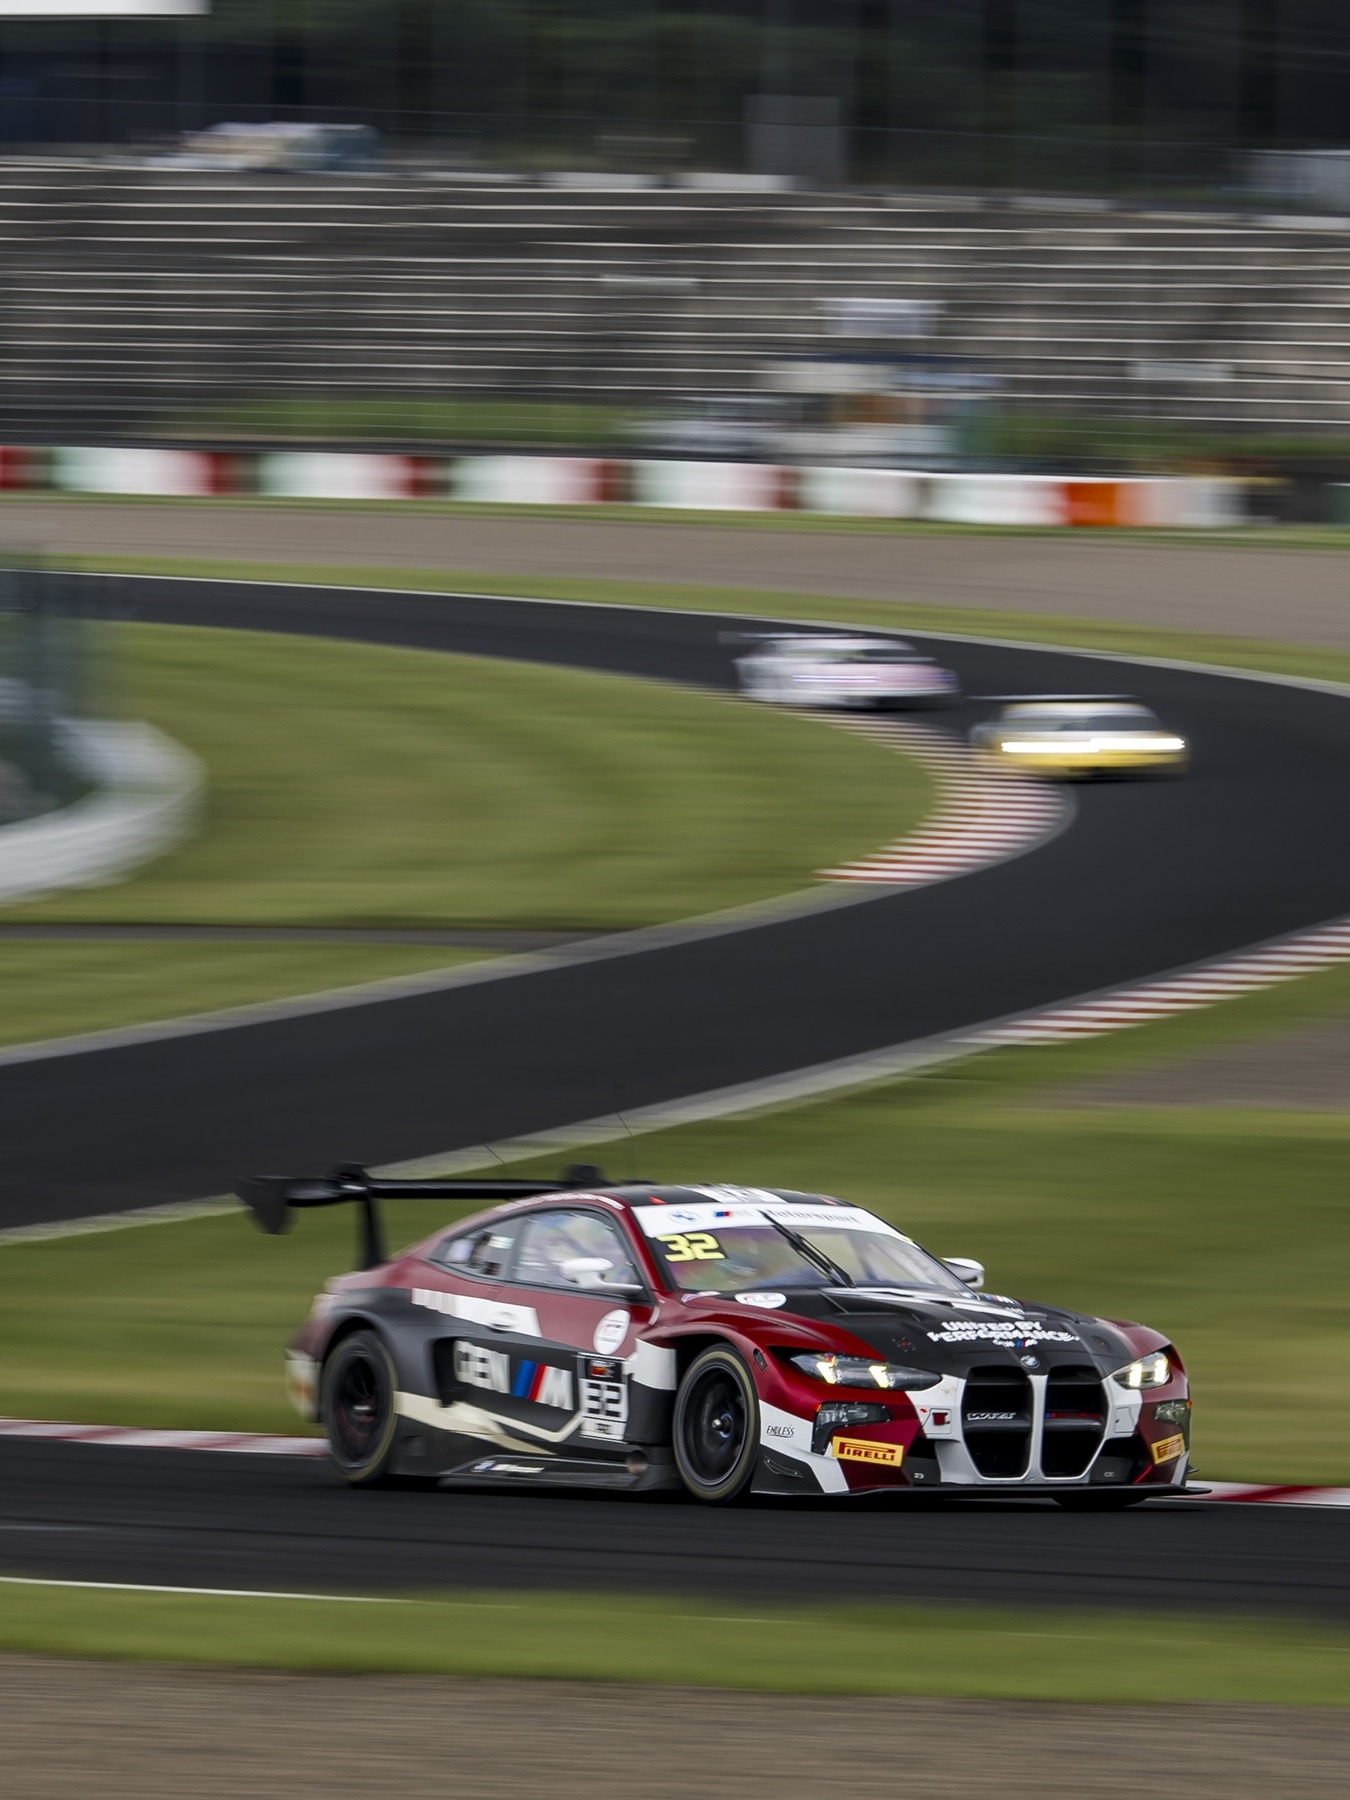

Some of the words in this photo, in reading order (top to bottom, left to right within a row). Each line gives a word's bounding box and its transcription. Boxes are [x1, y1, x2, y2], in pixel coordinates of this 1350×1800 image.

[656, 1233, 725, 1262] 32
[941, 1321, 1015, 1334] UNITED
[1014, 1320, 1042, 1331] BY
[766, 1424, 795, 1436] ENDLESS
[838, 1441, 896, 1462] PIRELLI
